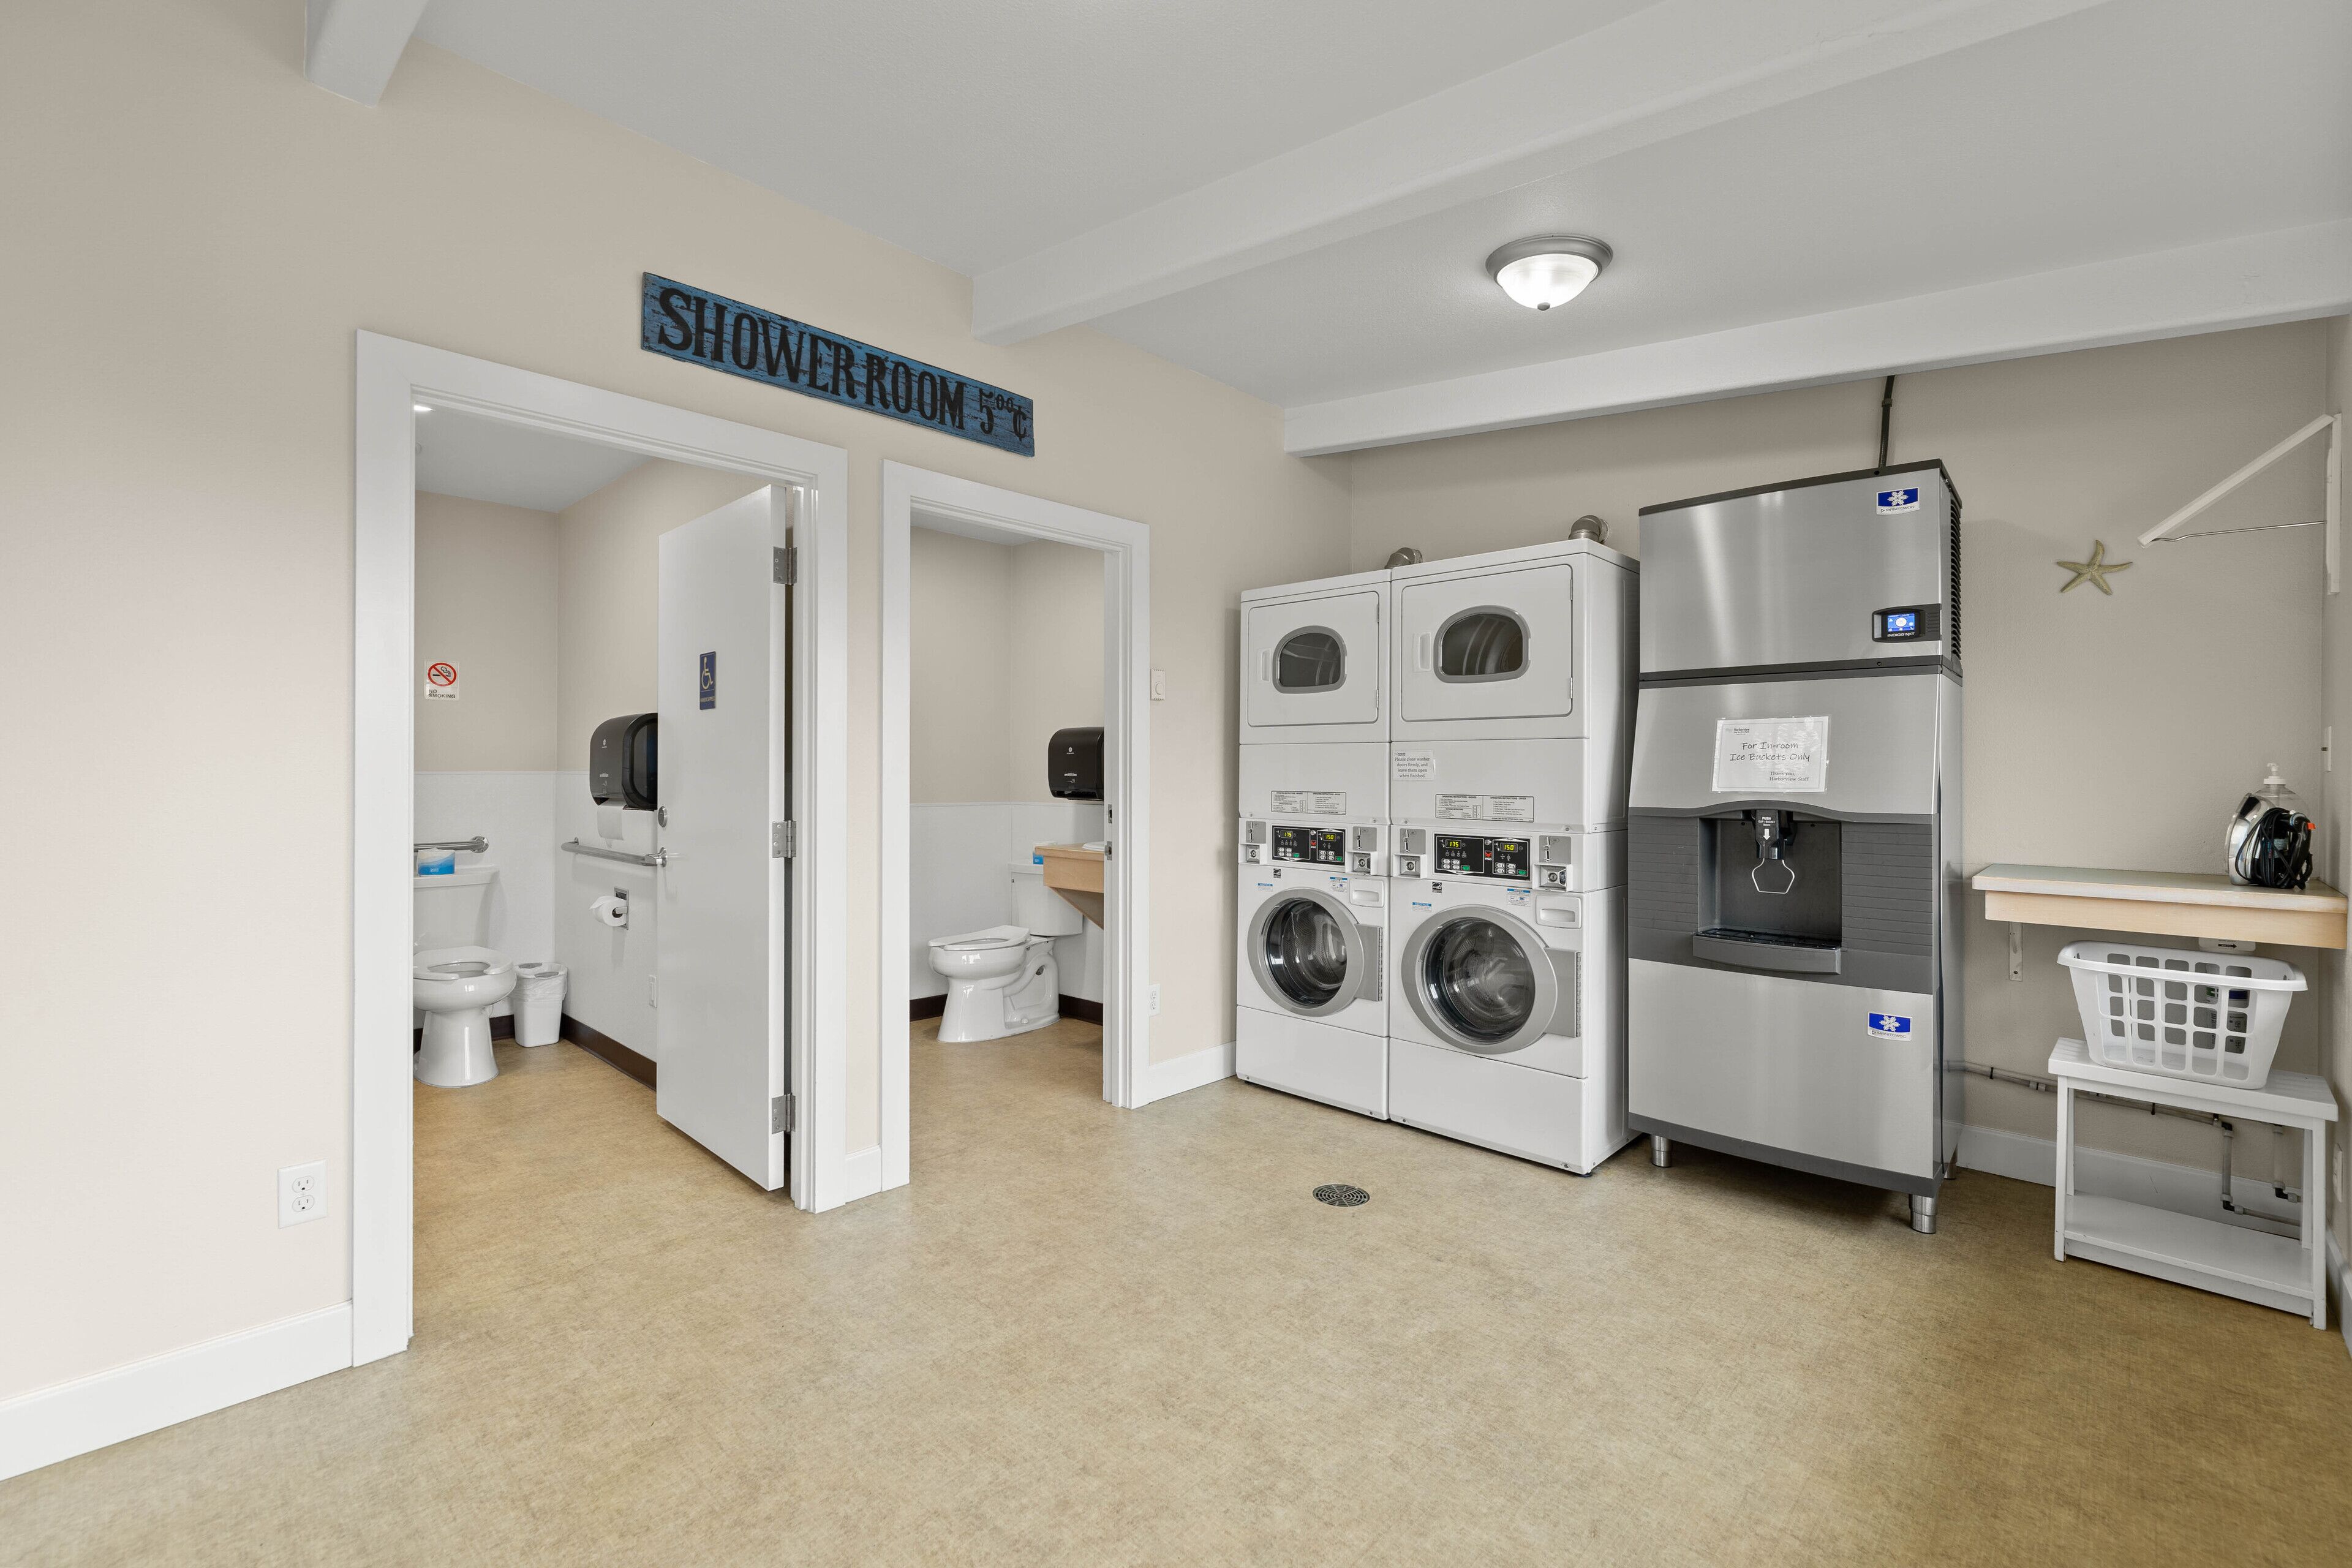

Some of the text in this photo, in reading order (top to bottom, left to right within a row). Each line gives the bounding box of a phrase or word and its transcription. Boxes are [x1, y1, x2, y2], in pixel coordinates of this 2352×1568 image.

[658, 288, 856, 399] SHOWER
[864, 352, 967, 430] ROOM
[1790, 753, 1810, 762] Only
